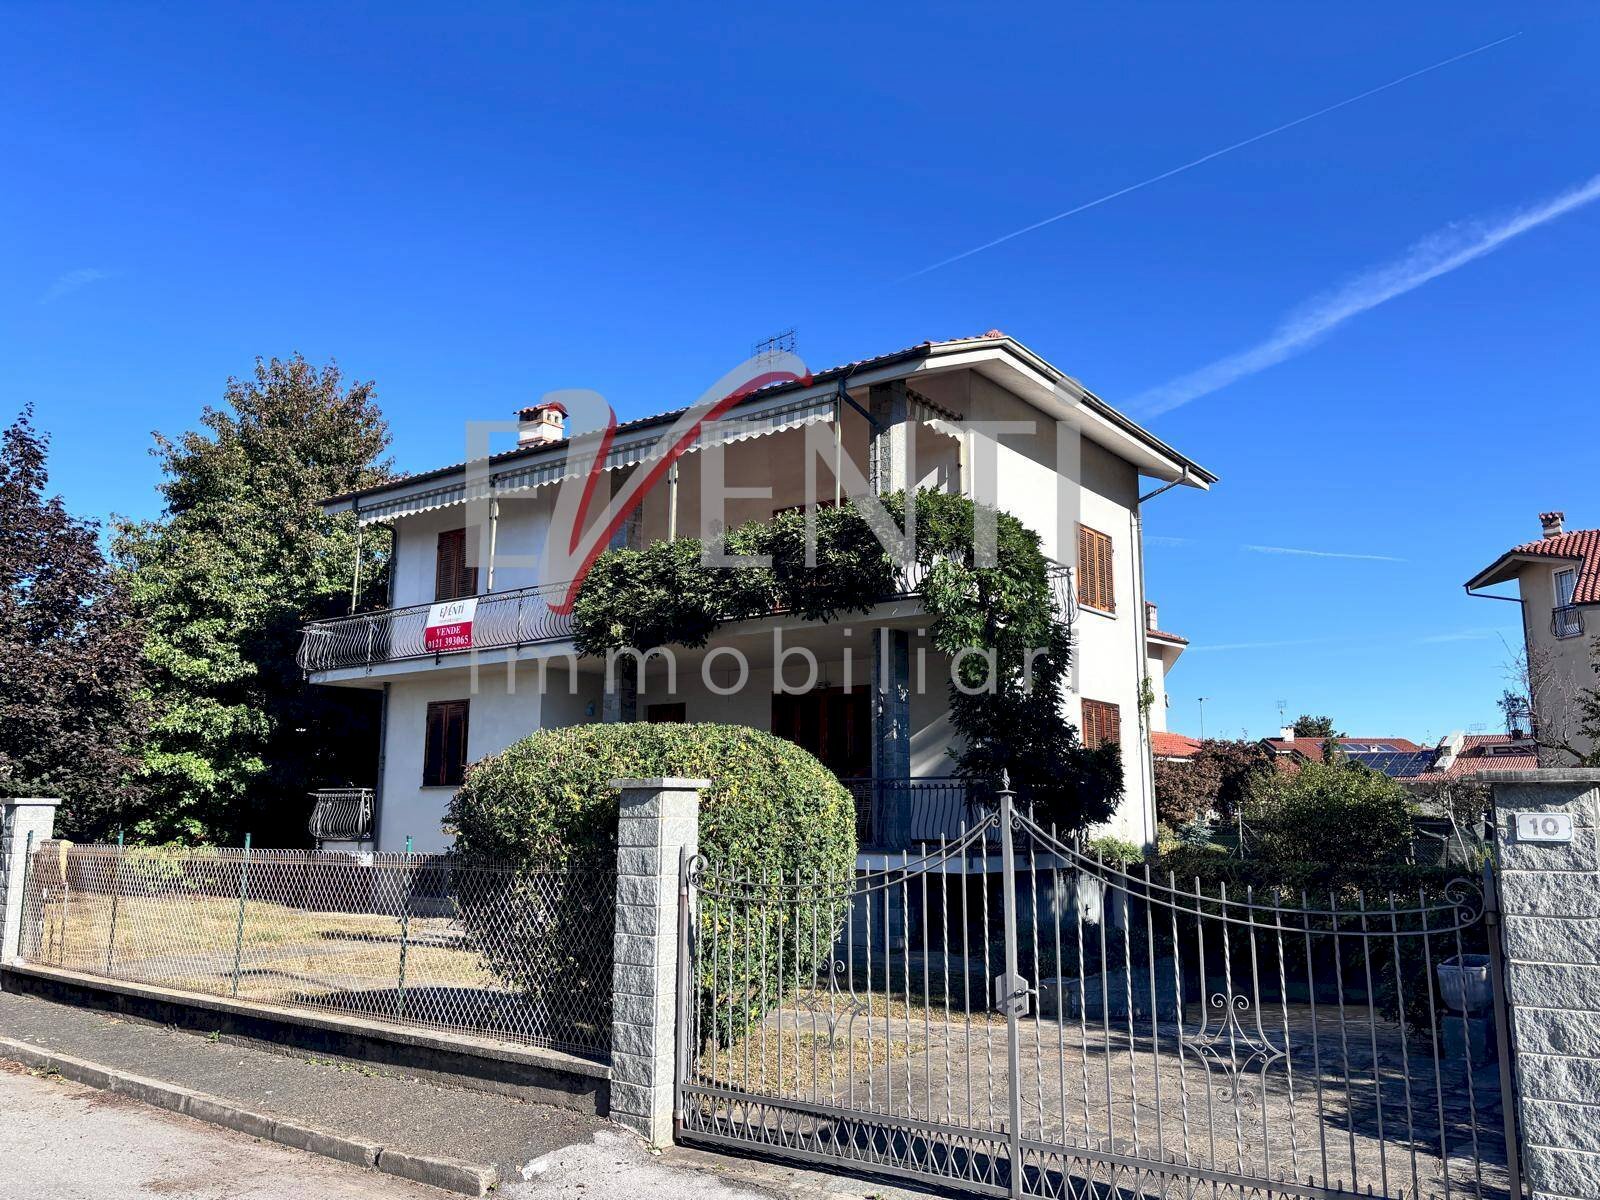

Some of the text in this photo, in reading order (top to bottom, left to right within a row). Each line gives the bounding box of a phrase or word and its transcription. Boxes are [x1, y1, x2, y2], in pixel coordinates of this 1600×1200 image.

[436, 625, 461, 636] VENDE
[427, 635, 469, 649] 0121 393065
[1529, 817, 1559, 836] 10
